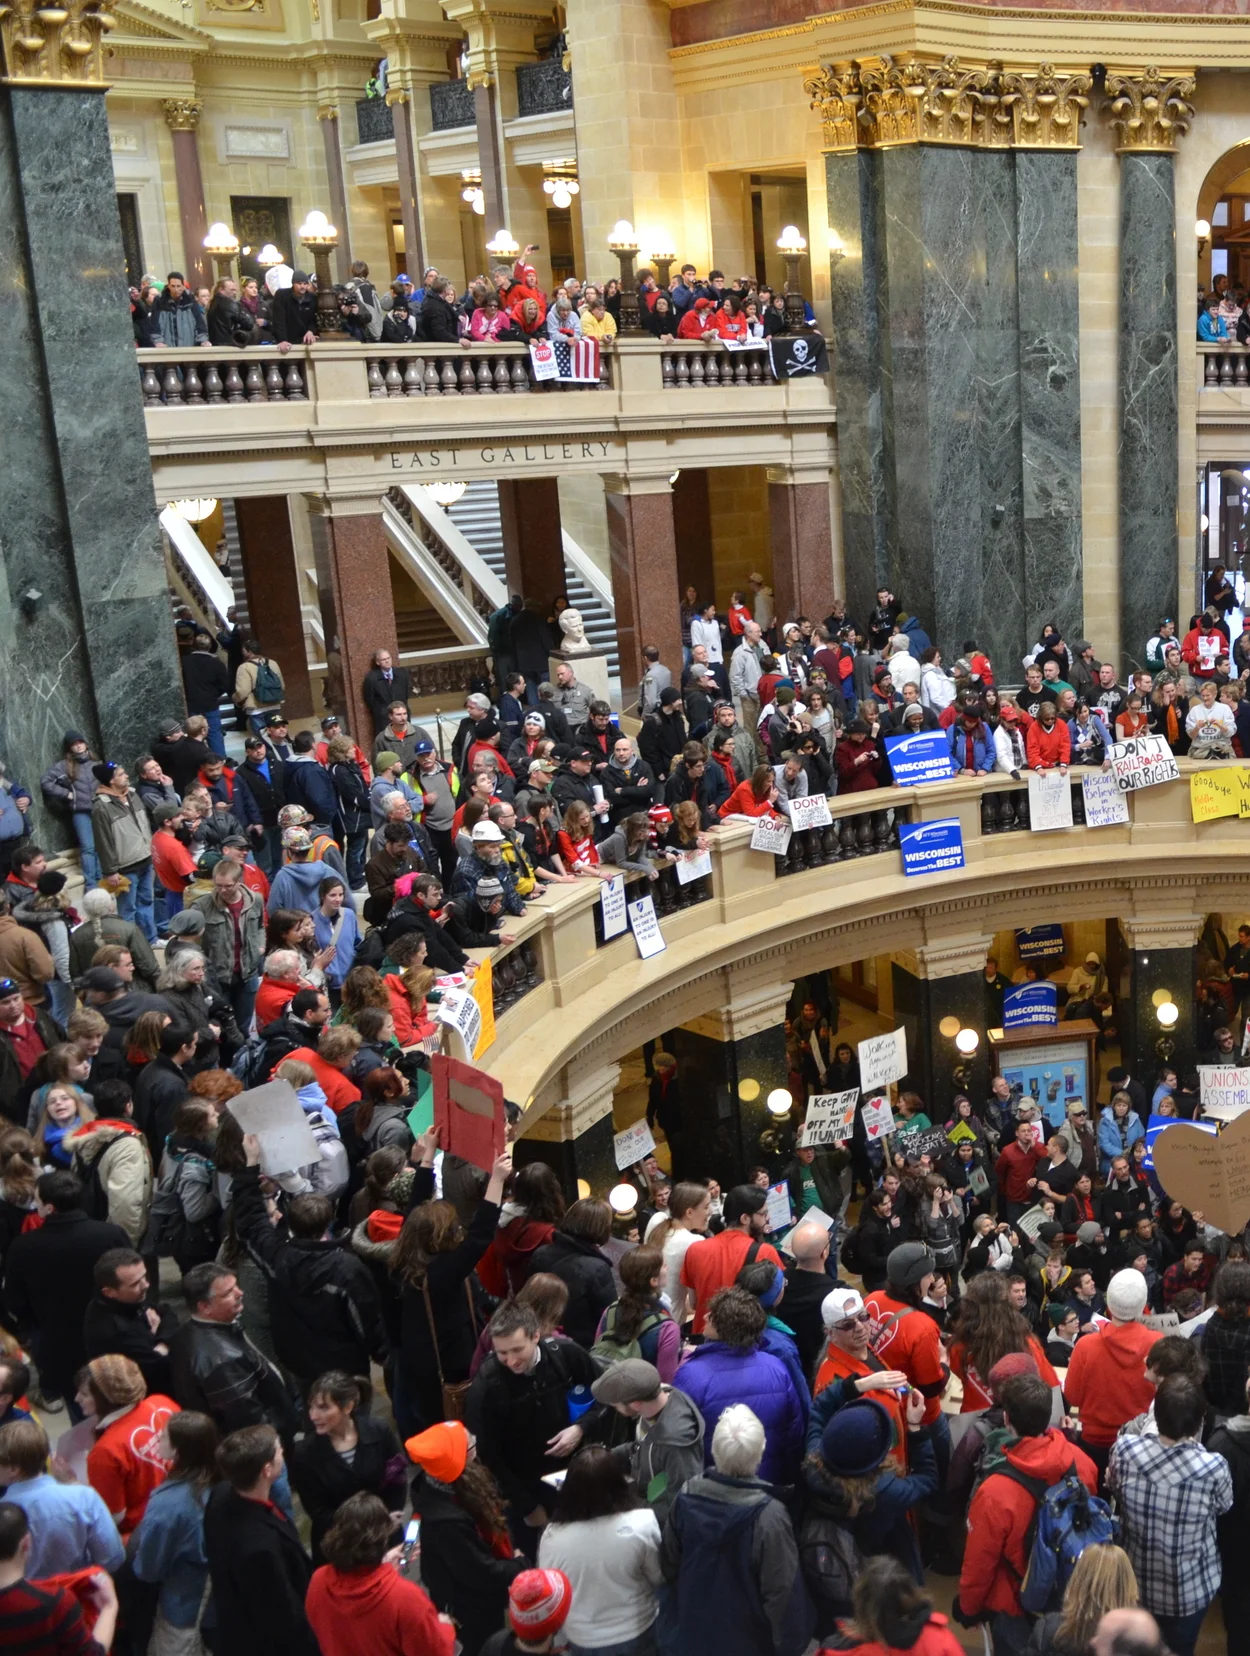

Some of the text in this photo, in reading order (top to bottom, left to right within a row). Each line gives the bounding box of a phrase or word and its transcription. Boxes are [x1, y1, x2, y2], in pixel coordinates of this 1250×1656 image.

[535, 350, 551, 359] STOP
[390, 440, 611, 469] EAST GALLERY
[893, 757, 951, 774] WISCONSIN
[925, 767, 952, 779] BEST
[1119, 771, 1143, 789] OUR
[1194, 775, 1232, 796] Goodbye
[793, 795, 826, 810] DON'T
[905, 846, 961, 862] WISCONSIN
[936, 856, 962, 868] BEST
[1019, 938, 1063, 950] WISCONSIN
[1043, 945, 1064, 955] BEST
[1005, 1005, 1057, 1018] WISCONSIN
[1031, 1014, 1057, 1023] BEST
[814, 1097, 838, 1109] Keep
[807, 1119, 841, 1130] OFF MY
[901, 1132, 923, 1146] STOP
[907, 1132, 944, 1149] FUCKING
